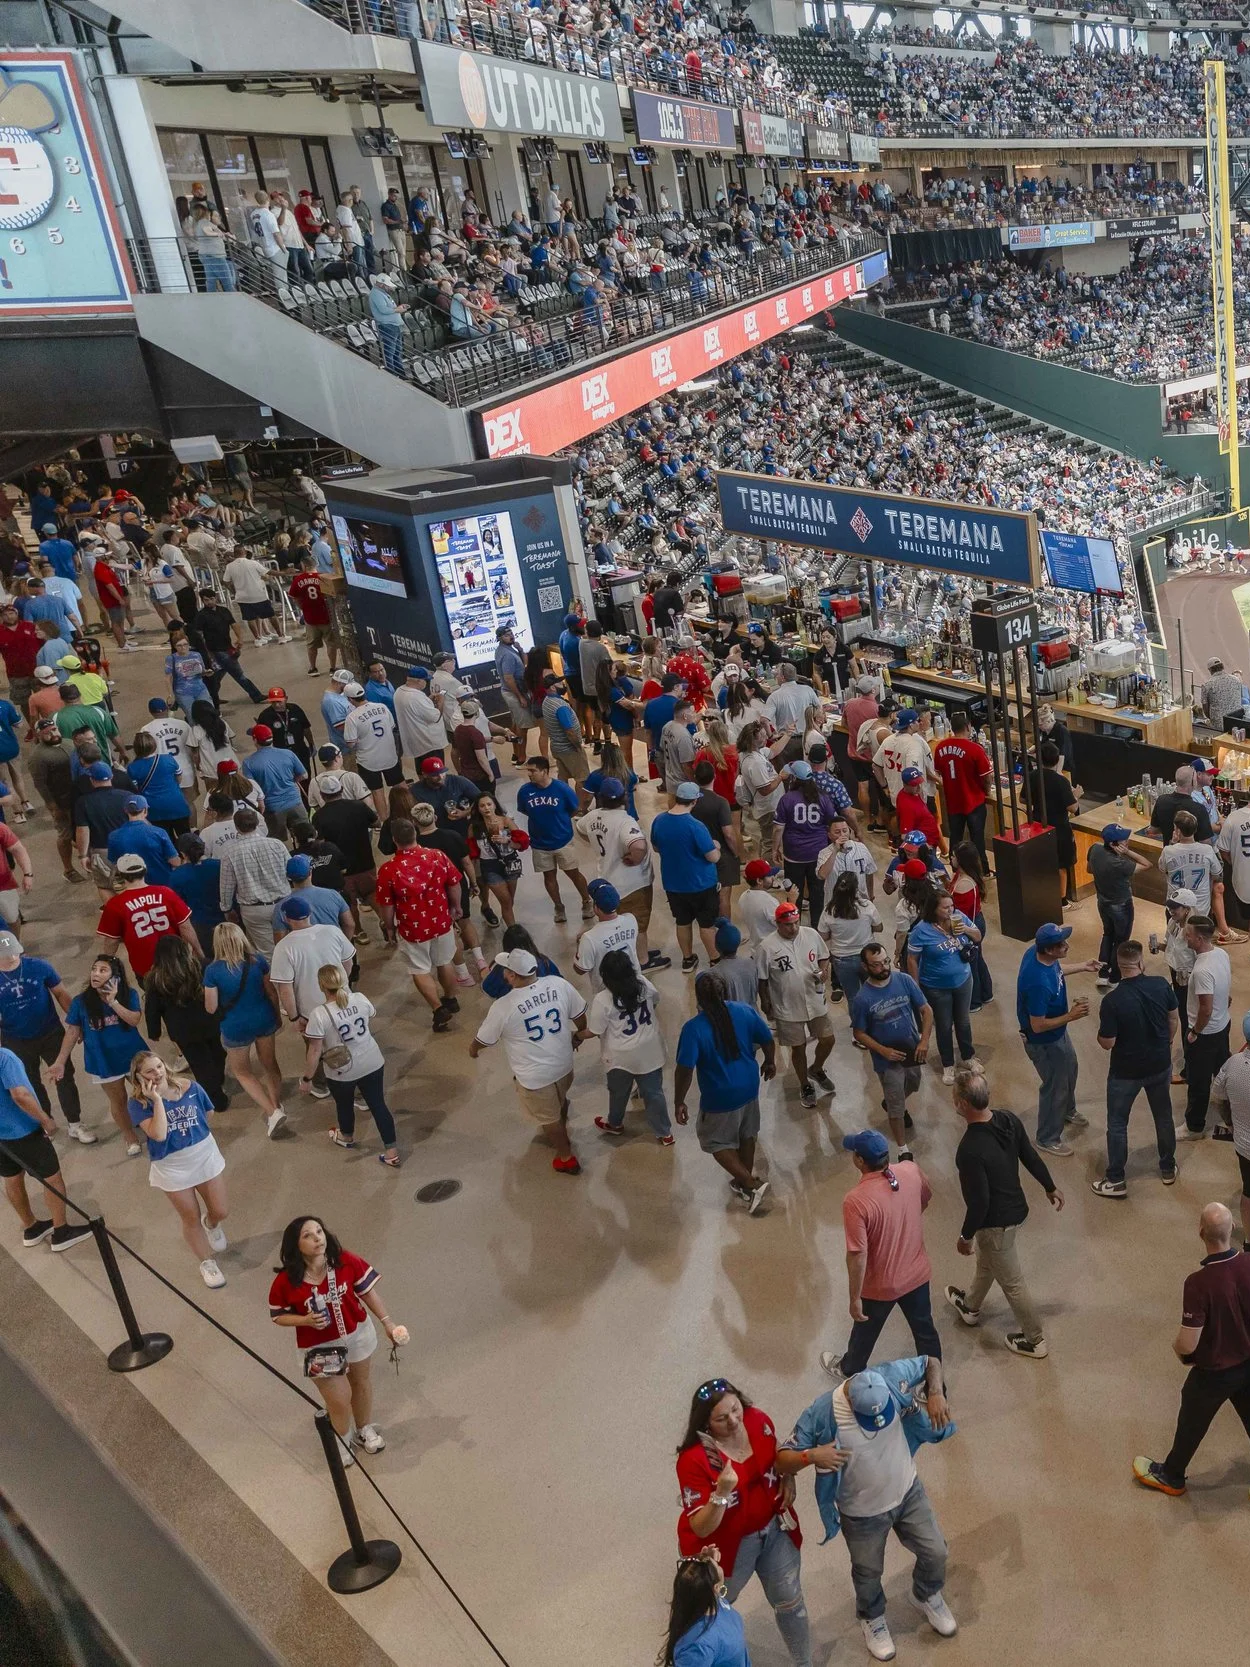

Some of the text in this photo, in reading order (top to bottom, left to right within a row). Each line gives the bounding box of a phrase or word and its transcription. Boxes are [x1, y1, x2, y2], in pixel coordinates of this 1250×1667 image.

[482, 64, 605, 137] UT DALLAS
[657, 101, 684, 140] 105.3
[64, 156, 80, 174] 3
[65, 195, 82, 214] 4
[10, 237, 26, 255] 6
[48, 228, 64, 244] 5
[776, 298, 788, 319] DEX
[744, 311, 758, 334] DEX
[704, 326, 720, 353] DEX
[651, 346, 672, 378] DEX
[581, 372, 610, 411] DEX
[592, 401, 615, 421] imaging
[484, 408, 524, 456] DEX
[737, 486, 838, 525] TEREMANA
[749, 514, 828, 537] SMALL BATCH TEQUILA
[884, 508, 1004, 553] TEREMANA
[523, 550, 562, 563] TEREMANA
[898, 539, 991, 565] SMALL BATCH TEQUILA
[530, 559, 558, 572] TOAST
[307, 586, 318, 600] 8
[996, 596, 1031, 612] Globe Life Field
[1004, 615, 1032, 644] 134
[390, 633, 433, 657] TEREMANA
[462, 674, 471, 686] T
[371, 720, 385, 738] 5
[165, 738, 180, 757] 5
[949, 760, 956, 779] 1
[528, 797, 560, 808] TEXAS
[793, 803, 820, 825] 06
[596, 835, 606, 857] 5
[854, 858, 866, 875] T
[1171, 869, 1206, 890] 47
[125, 894, 163, 912] NAPOLI
[132, 906, 170, 938] 25
[1, 937, 11, 947] T
[808, 950, 816, 963] 6
[11, 984, 24, 999] T
[518, 987, 560, 1015] GARCÍA
[524, 1008, 563, 1043] 53
[622, 1001, 652, 1036] 34
[339, 1018, 367, 1042] 23
[180, 1127, 188, 1136] T
[328, 1278, 338, 1302] TEXAS
[871, 1405, 882, 1415] T
